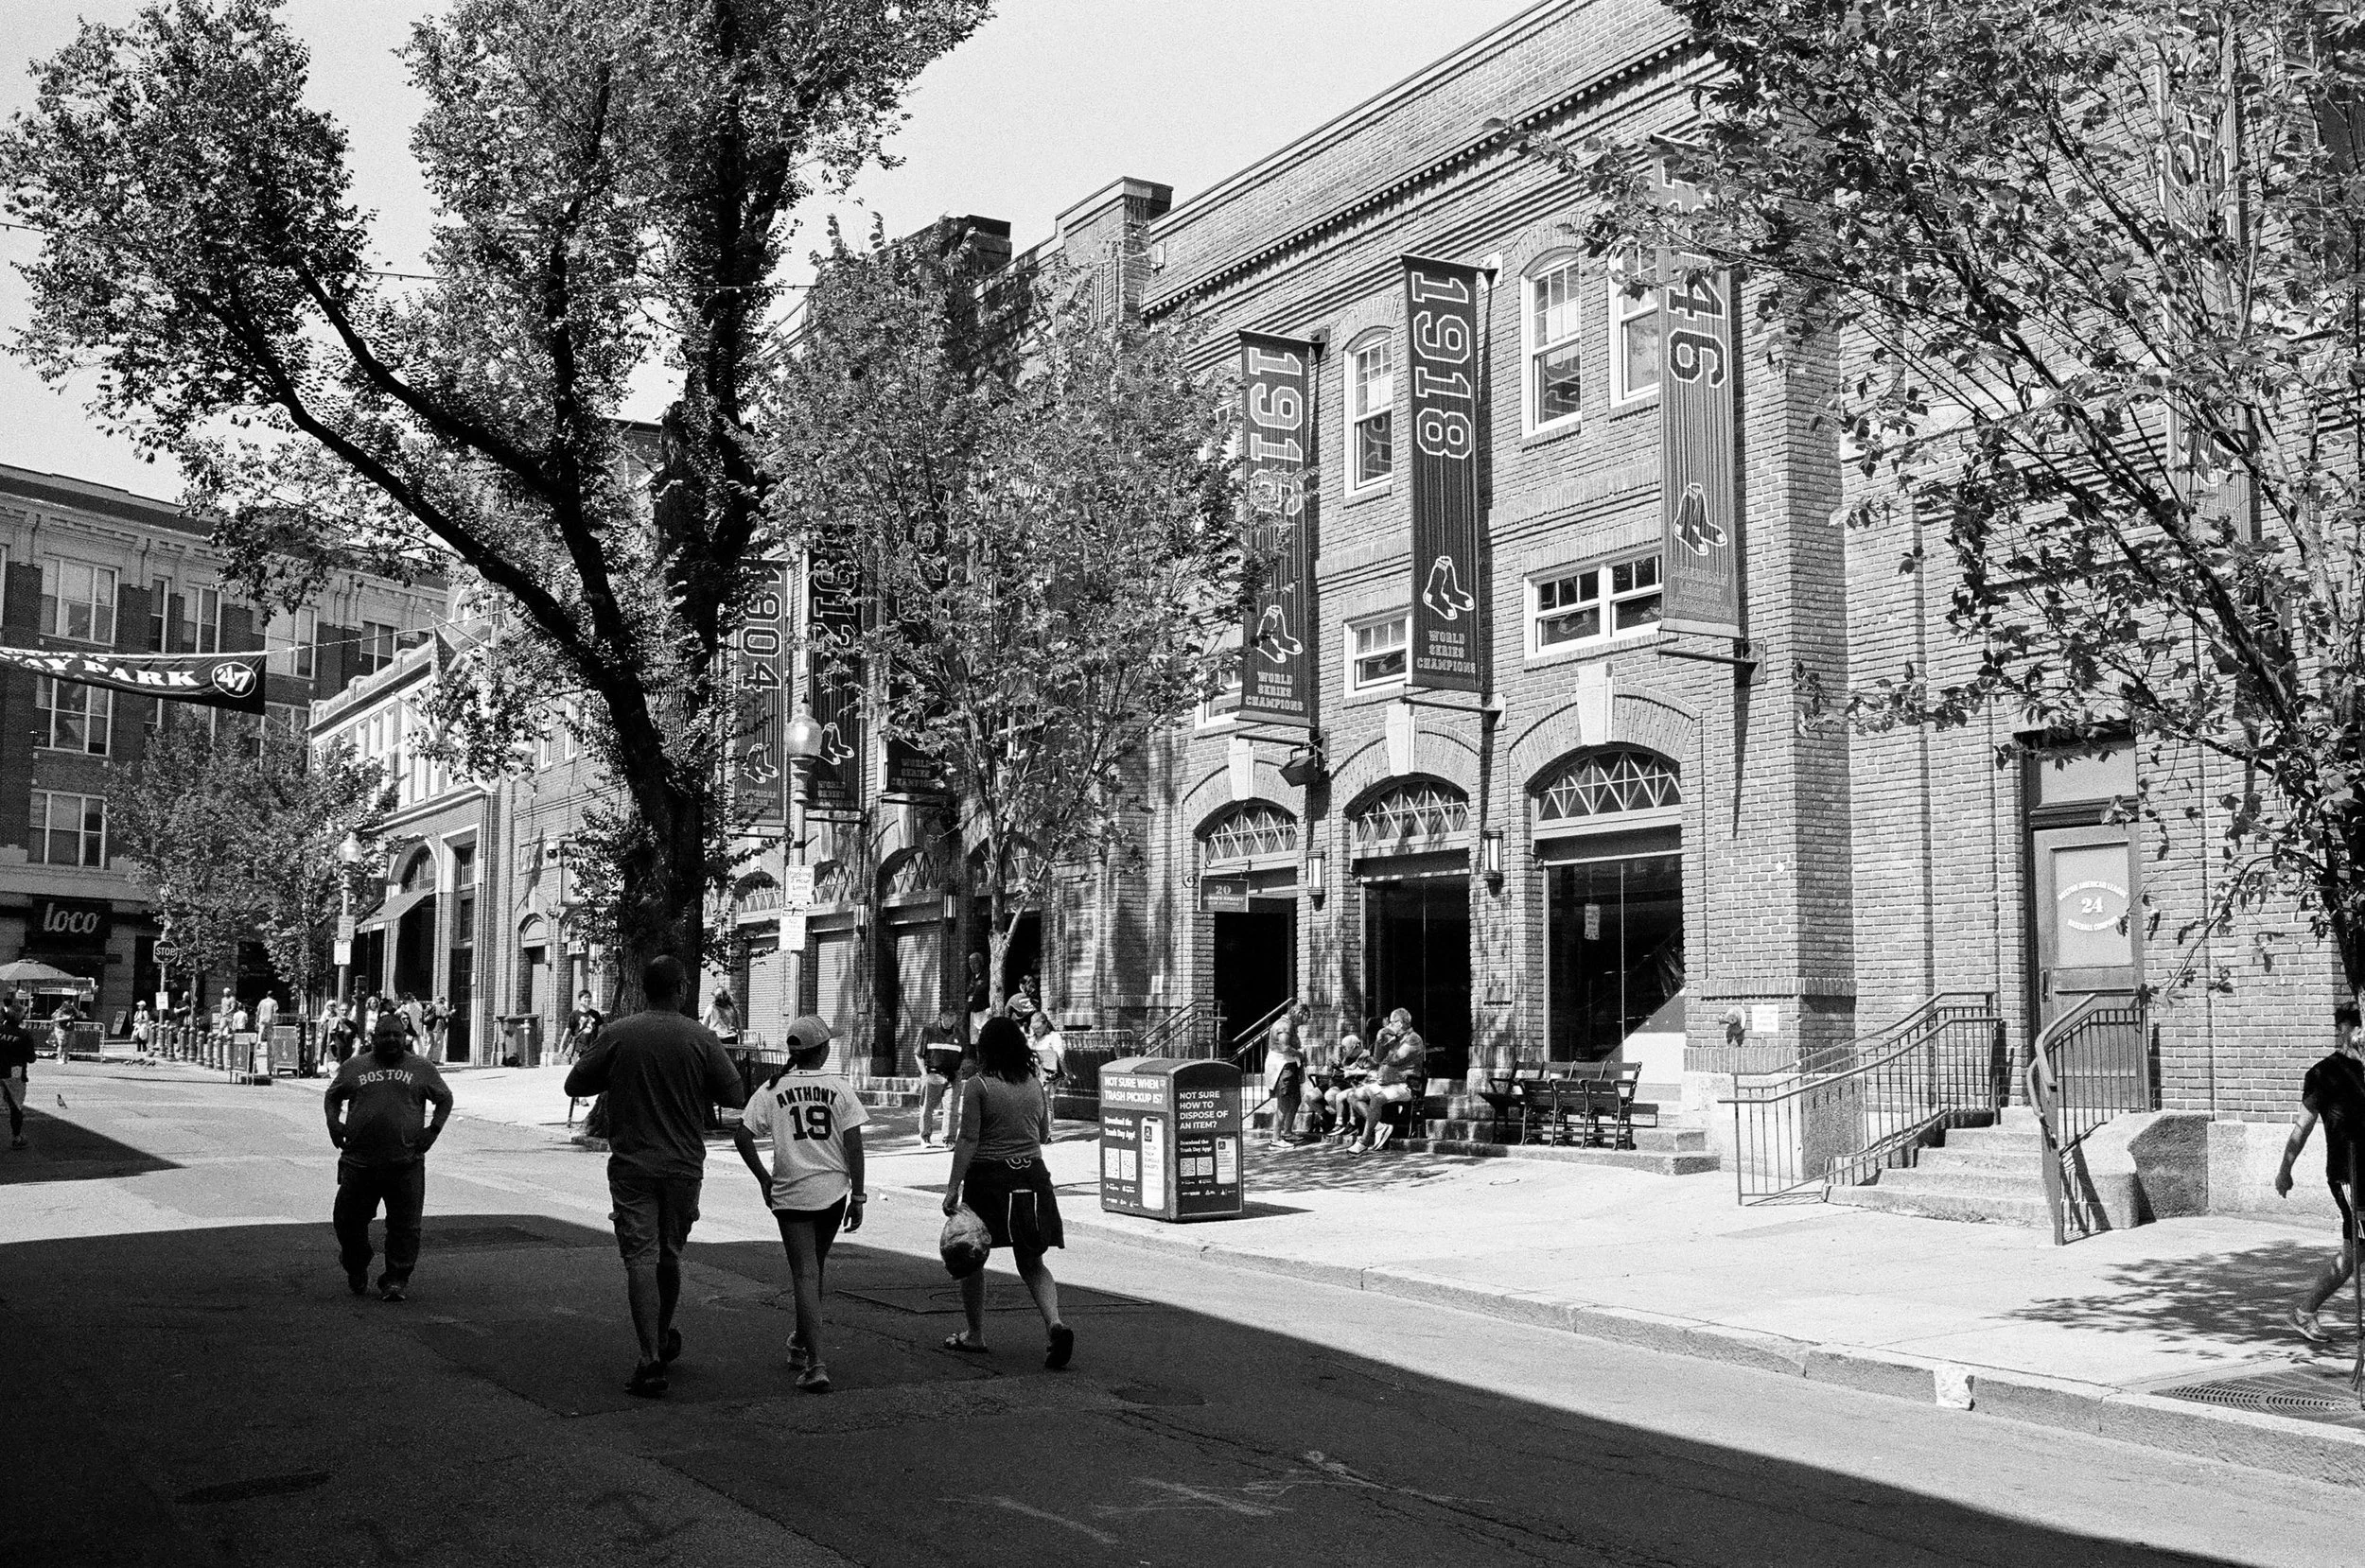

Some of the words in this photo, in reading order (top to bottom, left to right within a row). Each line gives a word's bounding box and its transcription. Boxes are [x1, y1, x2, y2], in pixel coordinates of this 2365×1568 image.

[1411, 270, 1472, 460] 1918
[1249, 346, 1304, 516] 1916
[1428, 630, 1465, 644] WORLD
[1428, 644, 1465, 659] SERIES
[82, 659, 201, 686] PARK
[1416, 657, 1476, 673] CHAMPIONS
[1257, 671, 1293, 685] WORLD
[1257, 684, 1292, 697] SERIES
[1245, 695, 1304, 711] CHAMPIONS
[1216, 884, 1232, 895] 20
[2080, 897, 2103, 914] 24
[43, 902, 101, 934] loco
[155, 947, 177, 956] STOP
[0, 1033, 19, 1042] AFF
[359, 1069, 413, 1085] BOSTON
[1104, 1076, 1117, 1087] NOT
[1118, 1077, 1136, 1088] SURE
[1137, 1078, 1159, 1089] WHEN
[776, 1086, 837, 1108] ANTHONY
[1104, 1089, 1126, 1102] TRASH
[1126, 1091, 1152, 1104] PICKUP
[1152, 1093, 1164, 1105] IS?
[1198, 1090, 1220, 1099] SURE
[1180, 1101, 1201, 1109] HOW
[1180, 1110, 1215, 1120] DISPOSE
[789, 1105, 832, 1141] 19
[1180, 1122, 1192, 1130] AN
[1192, 1120, 1218, 1129] ITEM?
